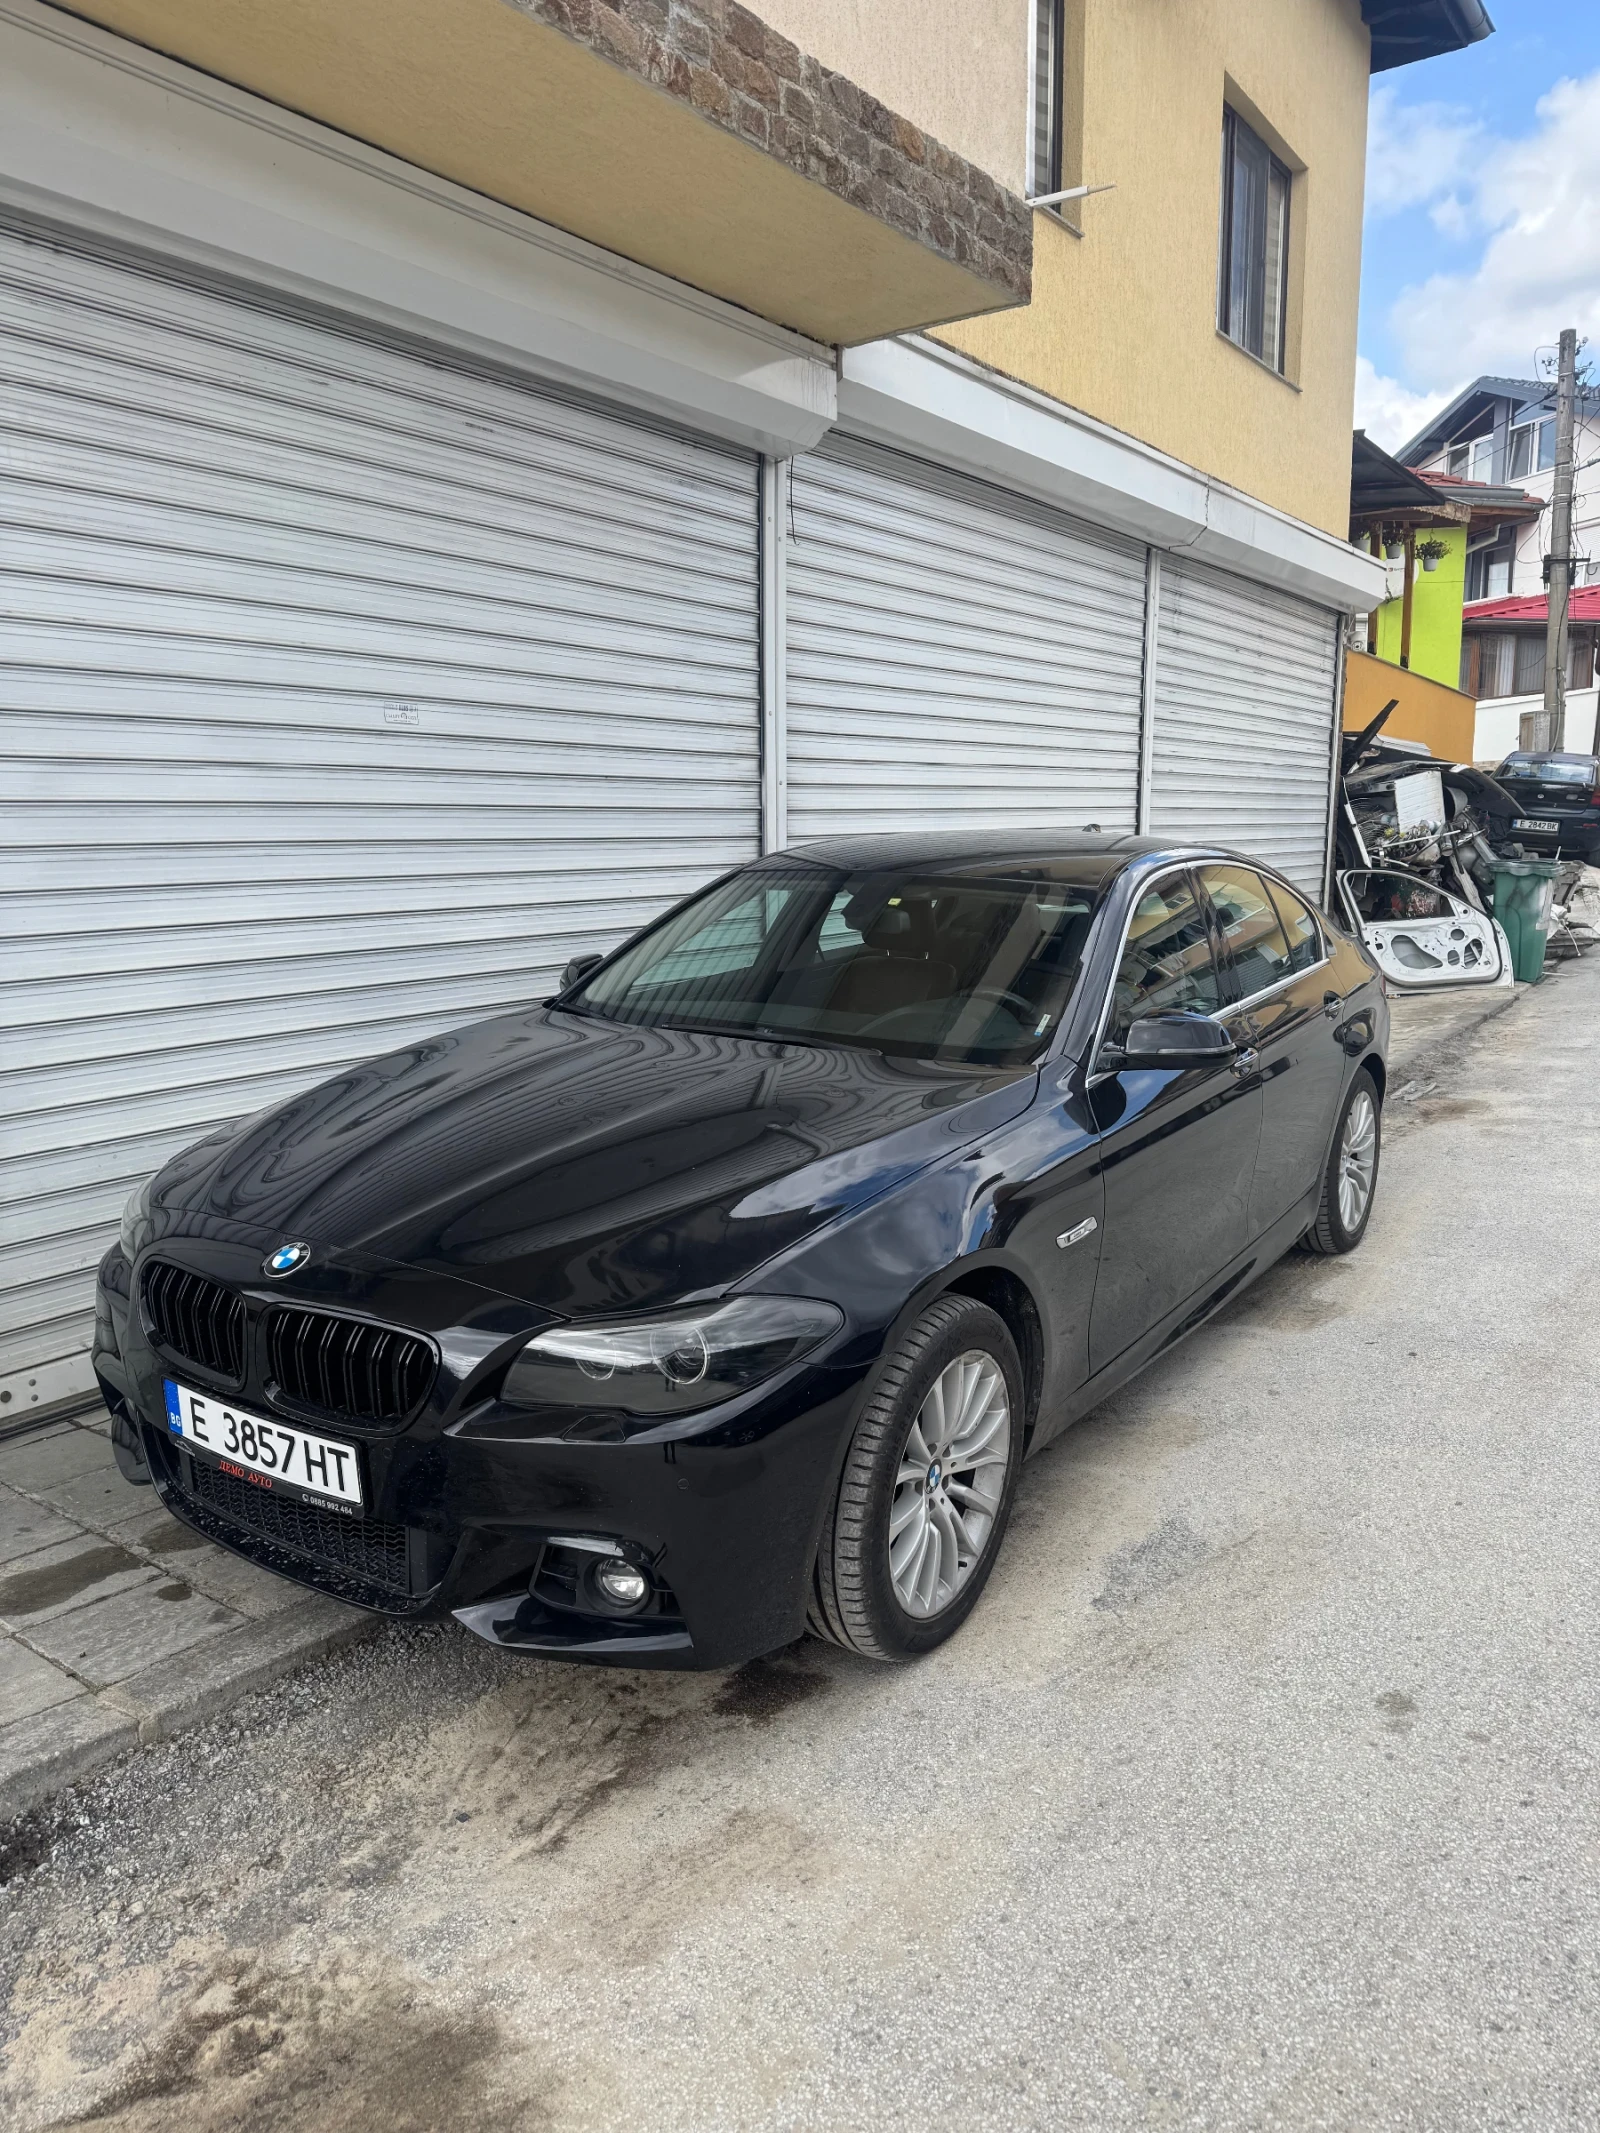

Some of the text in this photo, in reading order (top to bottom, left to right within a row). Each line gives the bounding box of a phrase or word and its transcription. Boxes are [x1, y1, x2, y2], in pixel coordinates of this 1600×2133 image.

[170, 1412, 181, 1427] BG
[190, 1396, 349, 1492] E 3857 HT
